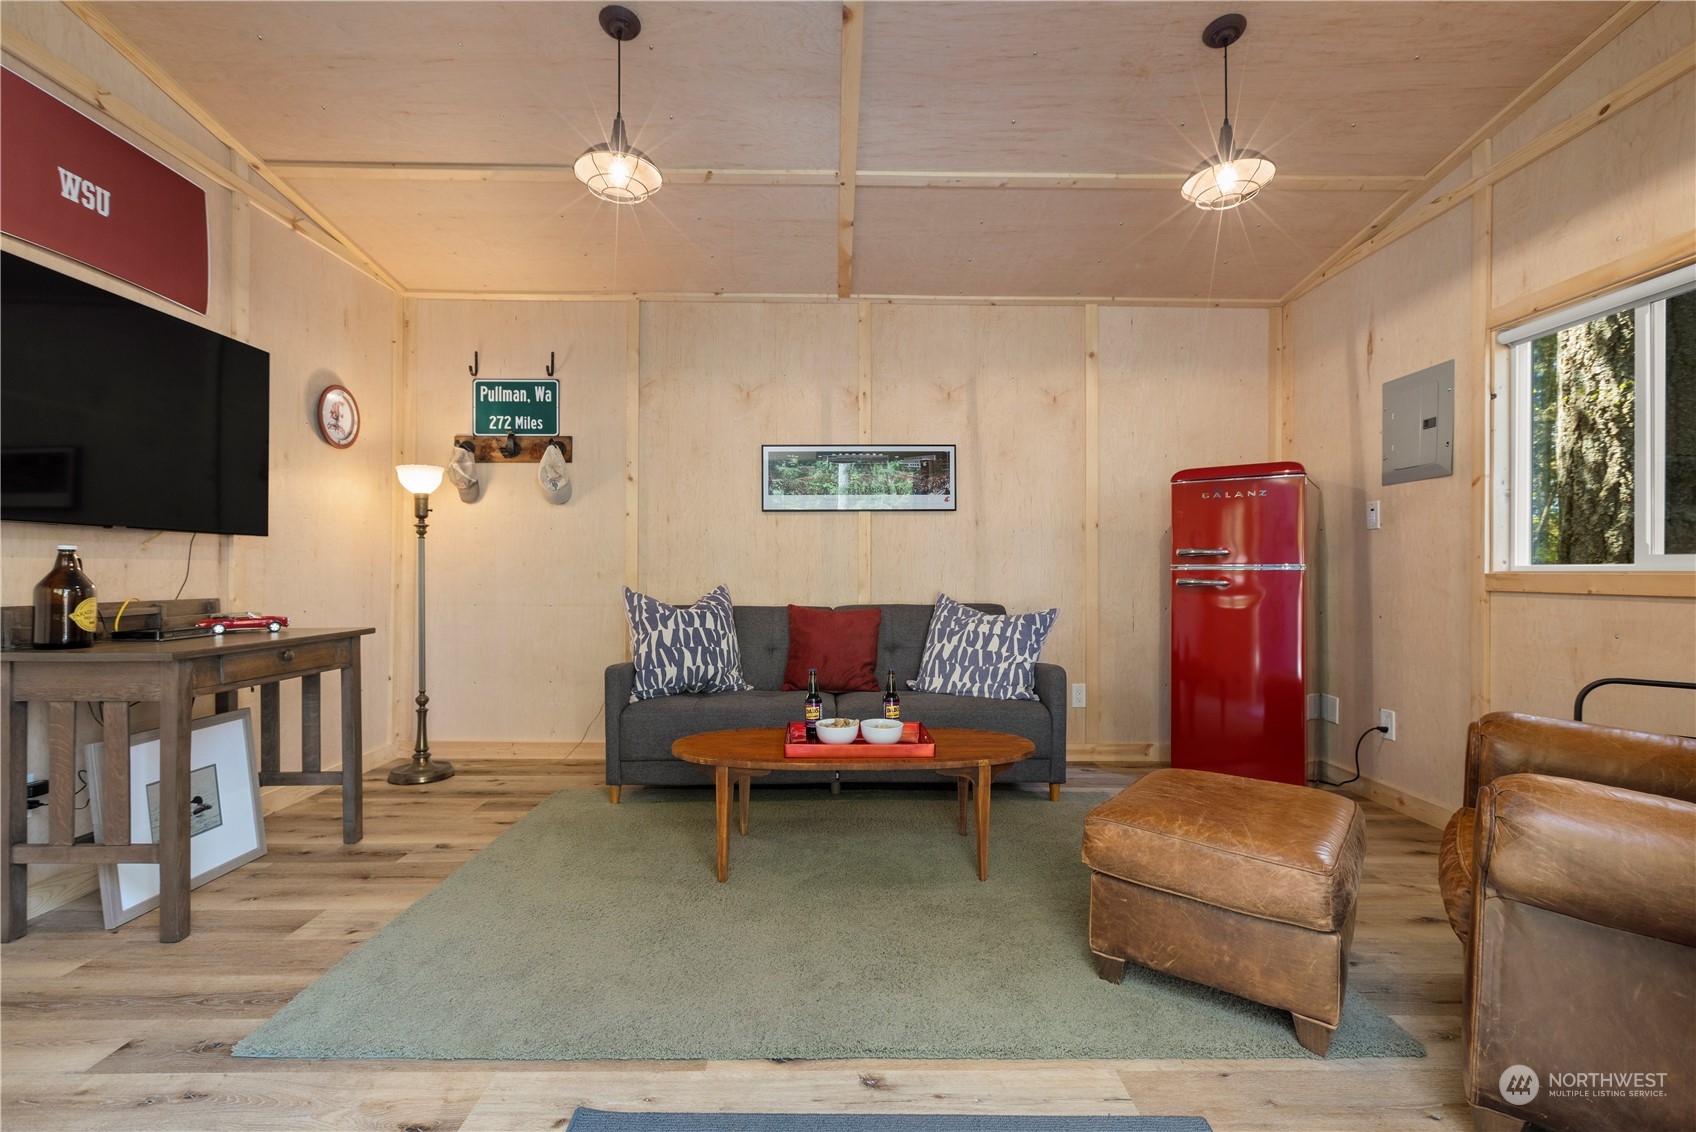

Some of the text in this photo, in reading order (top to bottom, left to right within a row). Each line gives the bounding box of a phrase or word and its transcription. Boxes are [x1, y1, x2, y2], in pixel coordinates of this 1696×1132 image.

[57, 165, 111, 218] WSU
[480, 385, 552, 404] Pullman, Wa
[489, 415, 543, 430] 272 Miles
[1202, 489, 1268, 498] GALANZ
